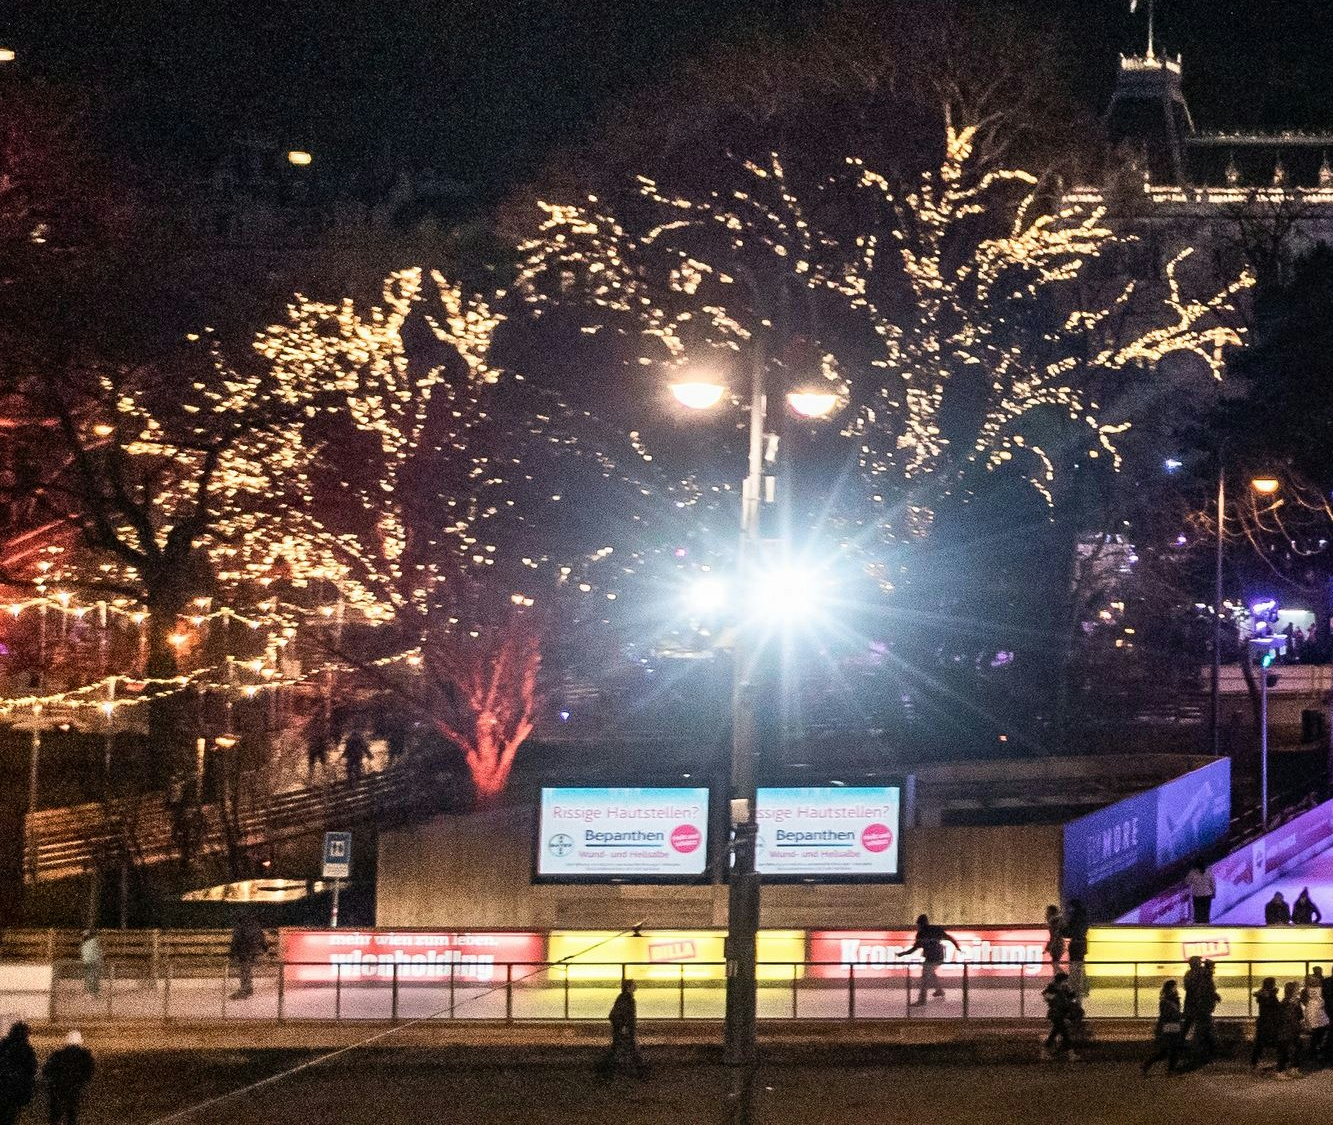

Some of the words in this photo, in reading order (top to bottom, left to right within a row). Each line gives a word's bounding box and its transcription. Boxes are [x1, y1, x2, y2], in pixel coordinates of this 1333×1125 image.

[552, 806, 601, 823] Rissige
[606, 806, 700, 819] Hautstellen?
[796, 805, 890, 819] Hautstellen?
[584, 829, 665, 843] Bepanthen
[776, 829, 855, 843] Bepanthen
[610, 850, 627, 858] und
[329, 932, 371, 946] mehr
[375, 932, 412, 946] wien
[414, 935, 448, 946] zum
[650, 942, 694, 961] BILLA
[329, 949, 494, 981] wienholding
